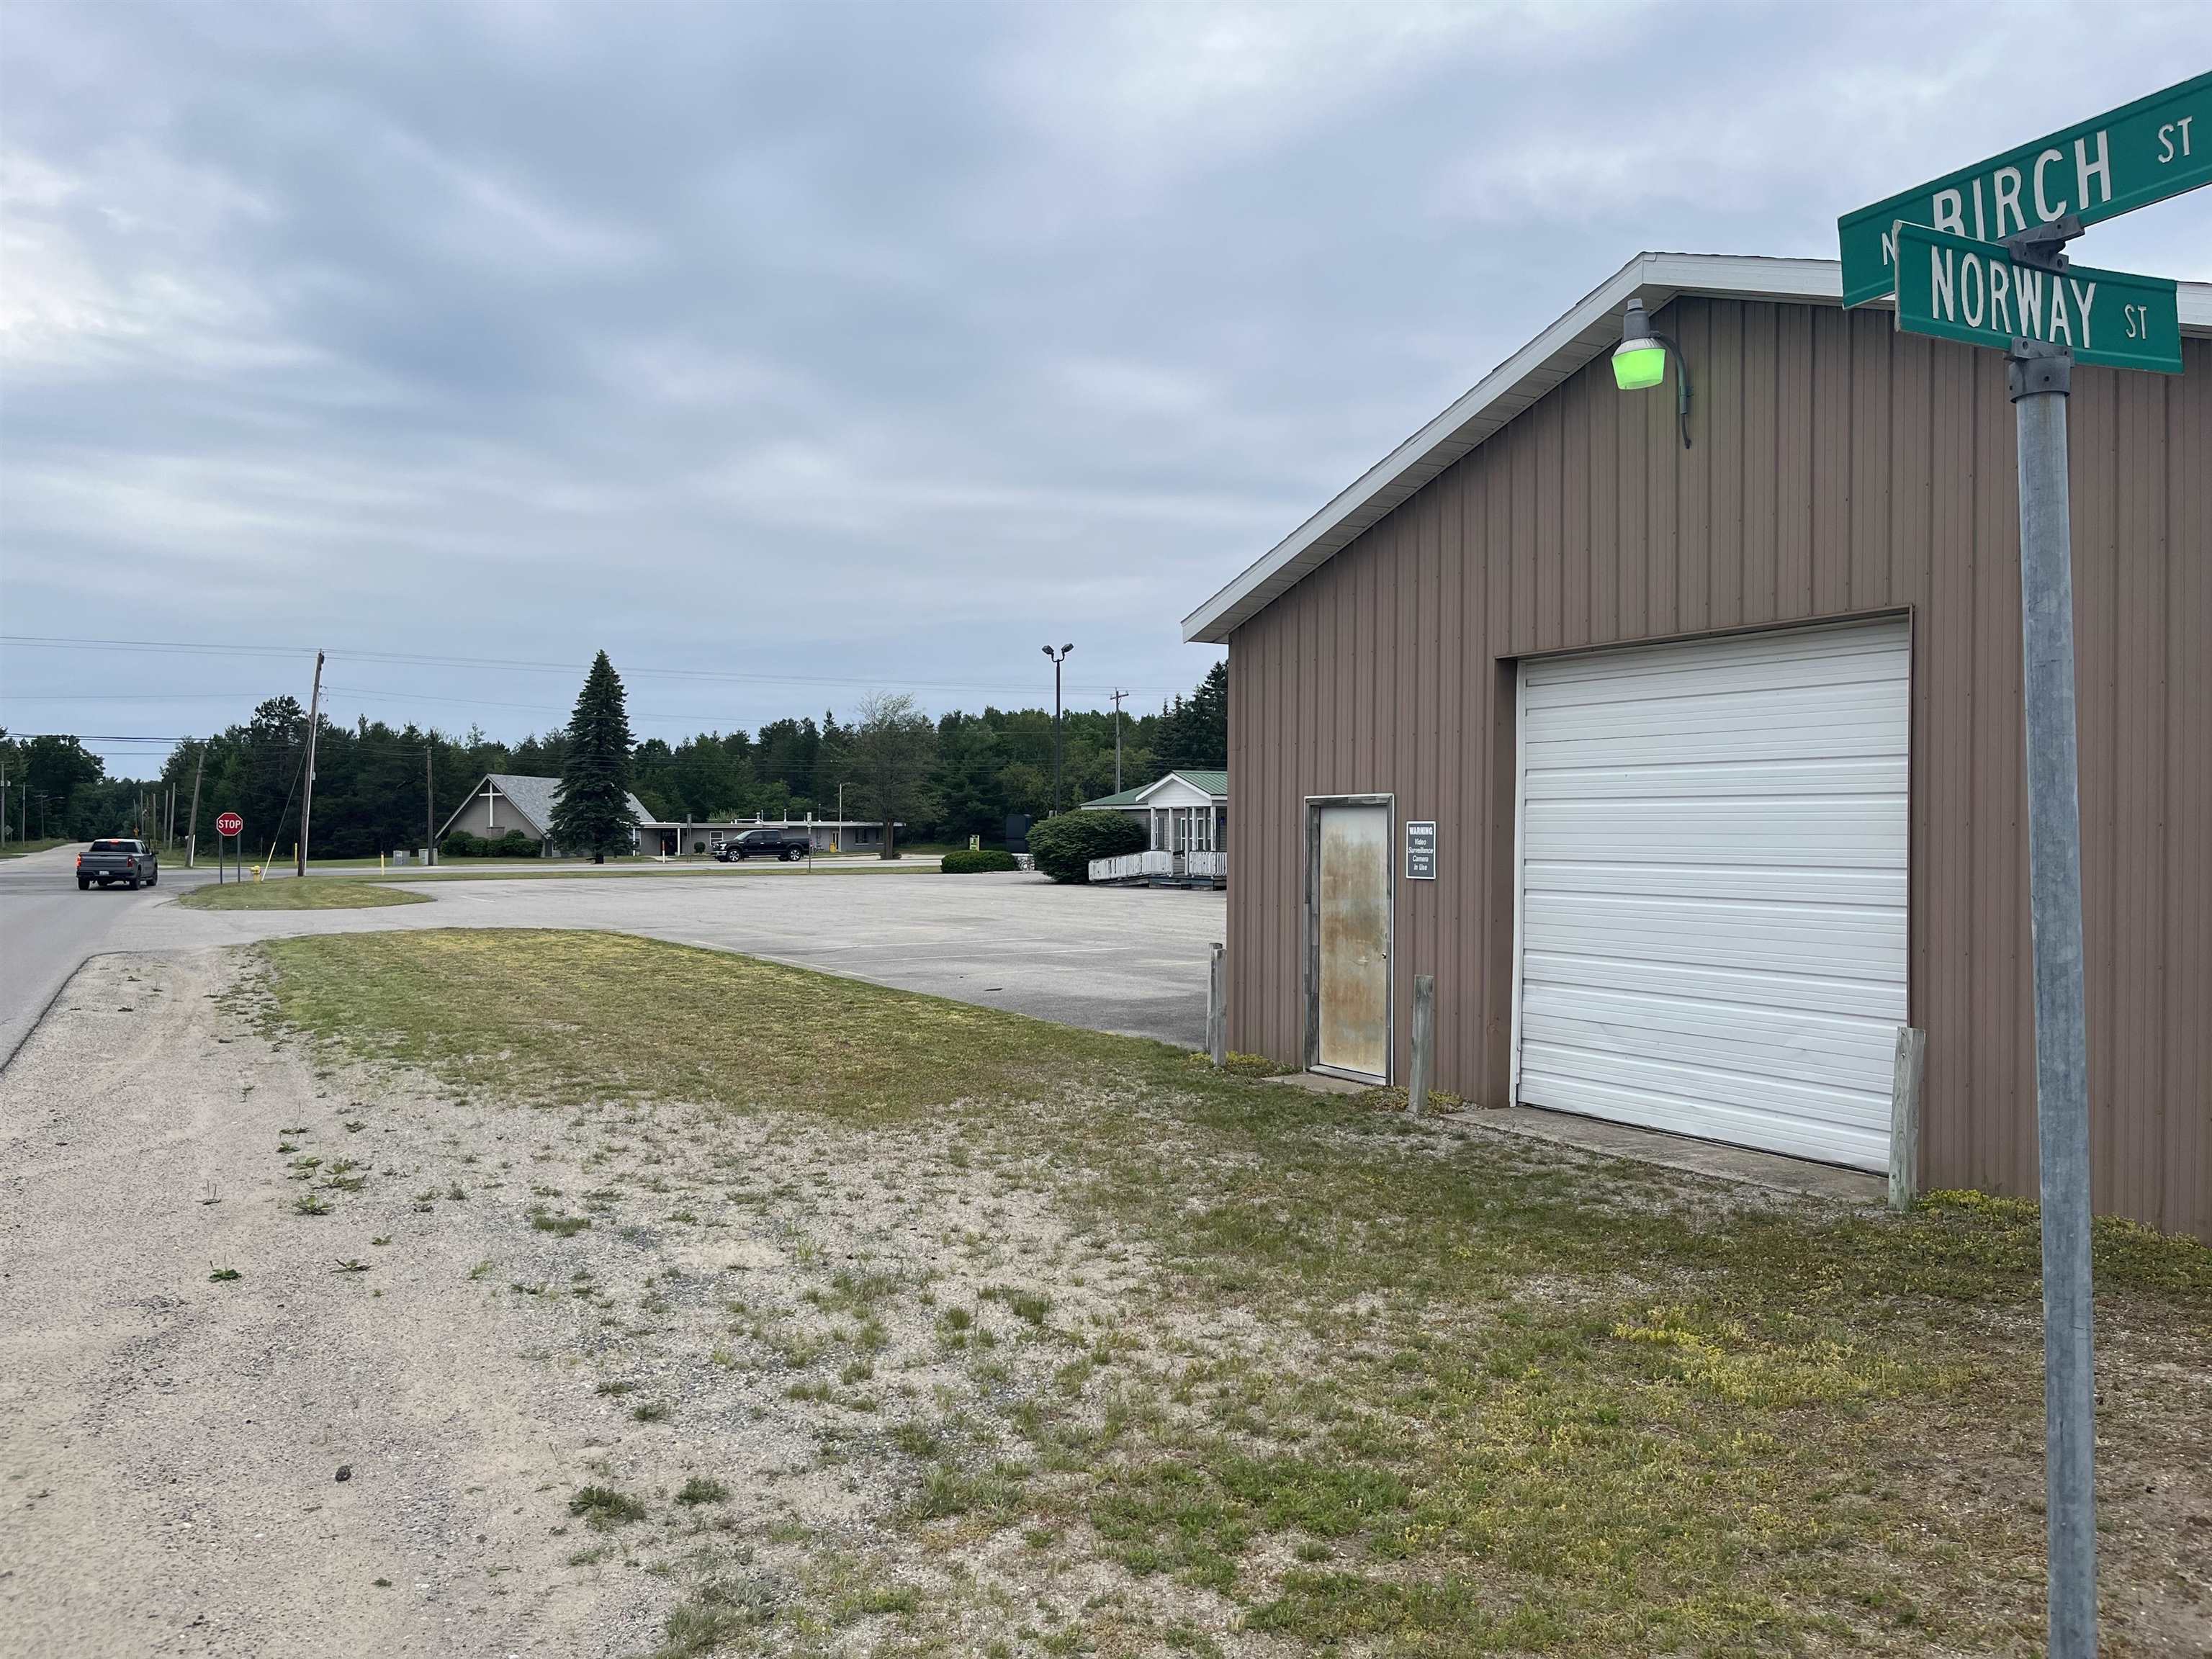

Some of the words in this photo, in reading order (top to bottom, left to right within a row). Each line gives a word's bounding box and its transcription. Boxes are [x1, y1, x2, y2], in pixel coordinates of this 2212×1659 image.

[1881, 229, 1897, 266] N
[1933, 130, 2112, 243] BIRCH
[2158, 115, 2193, 163] ST
[1931, 244, 2097, 349] NORWAY
[2124, 304, 2147, 340] ST
[218, 819, 241, 829] STOP
[1409, 827, 1433, 835] WARNING
